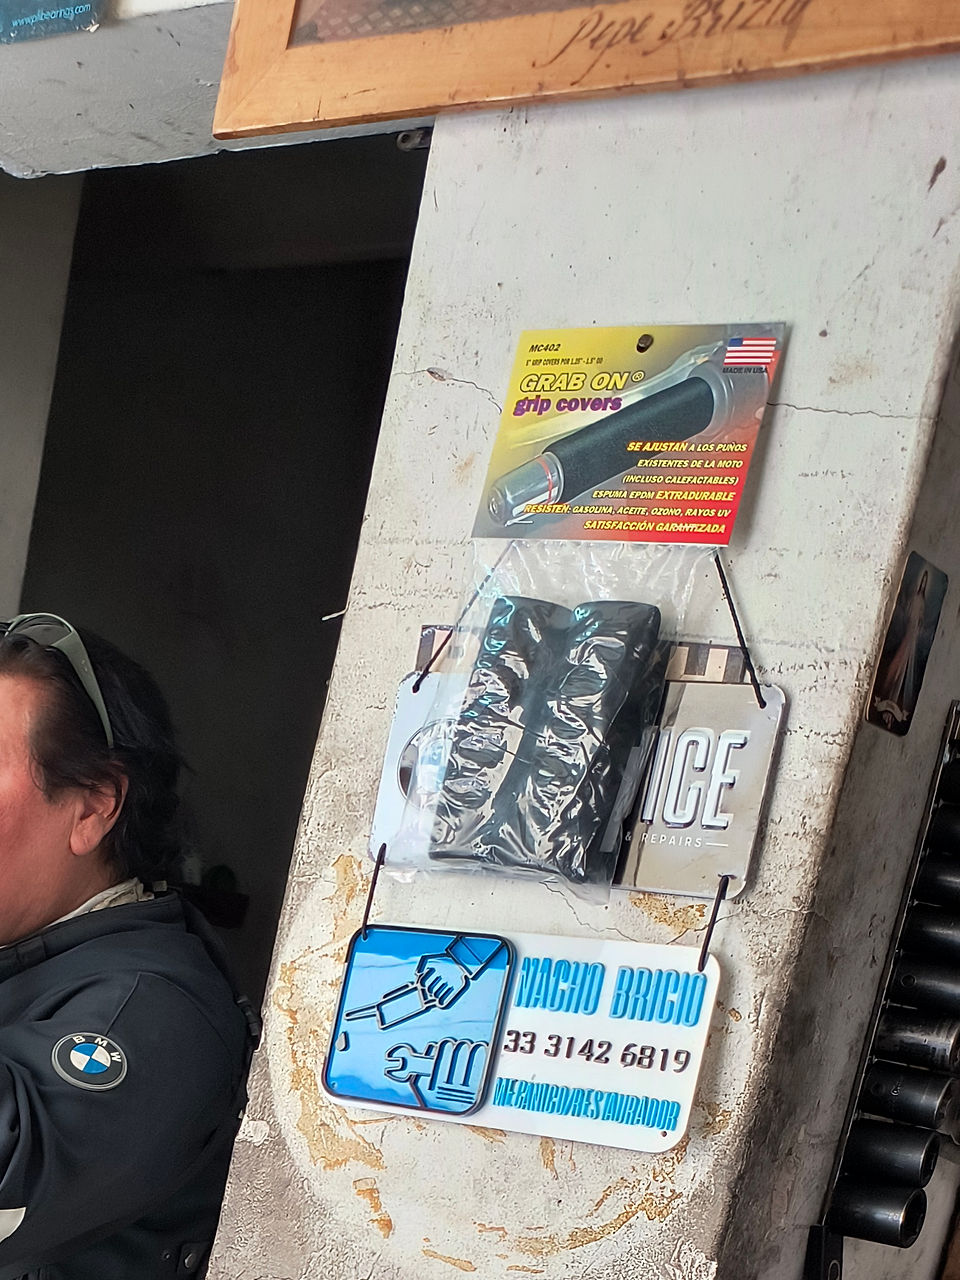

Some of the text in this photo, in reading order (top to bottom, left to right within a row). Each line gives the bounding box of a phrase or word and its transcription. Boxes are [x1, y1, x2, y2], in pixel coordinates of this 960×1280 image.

[532, 10, 653, 86] Pepe
[529, 344, 561, 352] MC402
[519, 372, 585, 393] GRAB
[590, 370, 627, 391] ON
[513, 395, 622, 416] grip covers
[627, 442, 641, 451] SE
[642, 442, 688, 452] AJUSTAN
[688, 443, 695, 452] A
[696, 443, 714, 452] LOS
[637, 459, 743, 468] EXISTENTES DE LA MOTO
[622, 475, 739, 486] (INCLUSO CALEFACTABLES)
[592, 490, 736, 501] ESPUMA EPDM EXTRADURABLE
[524, 504, 732, 517] RESISTEN: GASOLINA, ACEITE, OZONO, RAYOS UV
[583, 520, 726, 534] SATISFACCIÓN GARANTIZADA
[640, 726, 752, 830] ICE
[641, 833, 703, 848] REPAIRS
[515, 957, 707, 1028] NACHO BRICIO
[73, 1035, 122, 1062] BMW
[504, 1030, 692, 1073] 33 3142 6819
